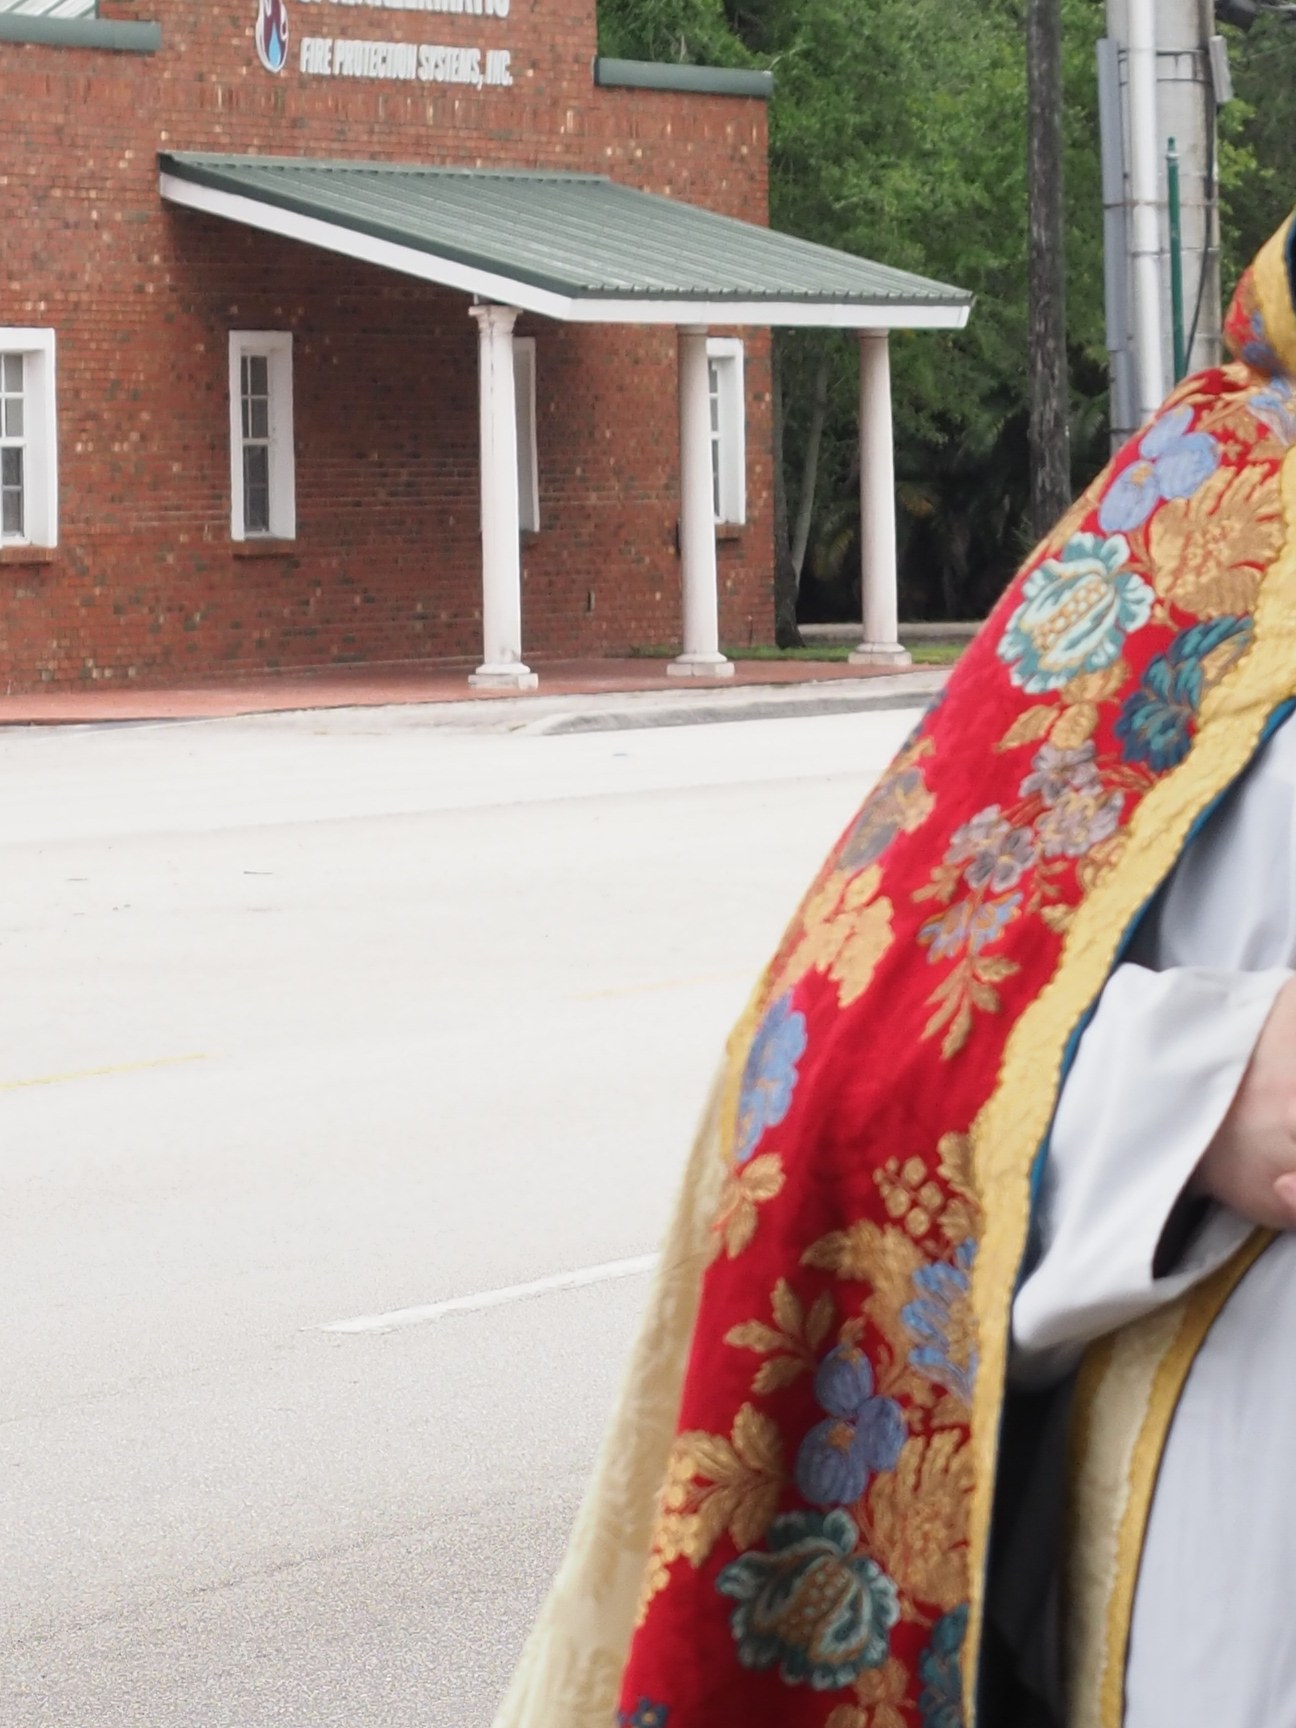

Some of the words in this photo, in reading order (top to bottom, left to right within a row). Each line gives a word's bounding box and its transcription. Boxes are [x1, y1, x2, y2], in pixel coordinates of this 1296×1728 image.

[300, 37, 332, 75] FIRE
[333, 39, 418, 80] PROTECTION
[418, 44, 483, 91] SYSTEMS,
[485, 50, 513, 86] INC.
